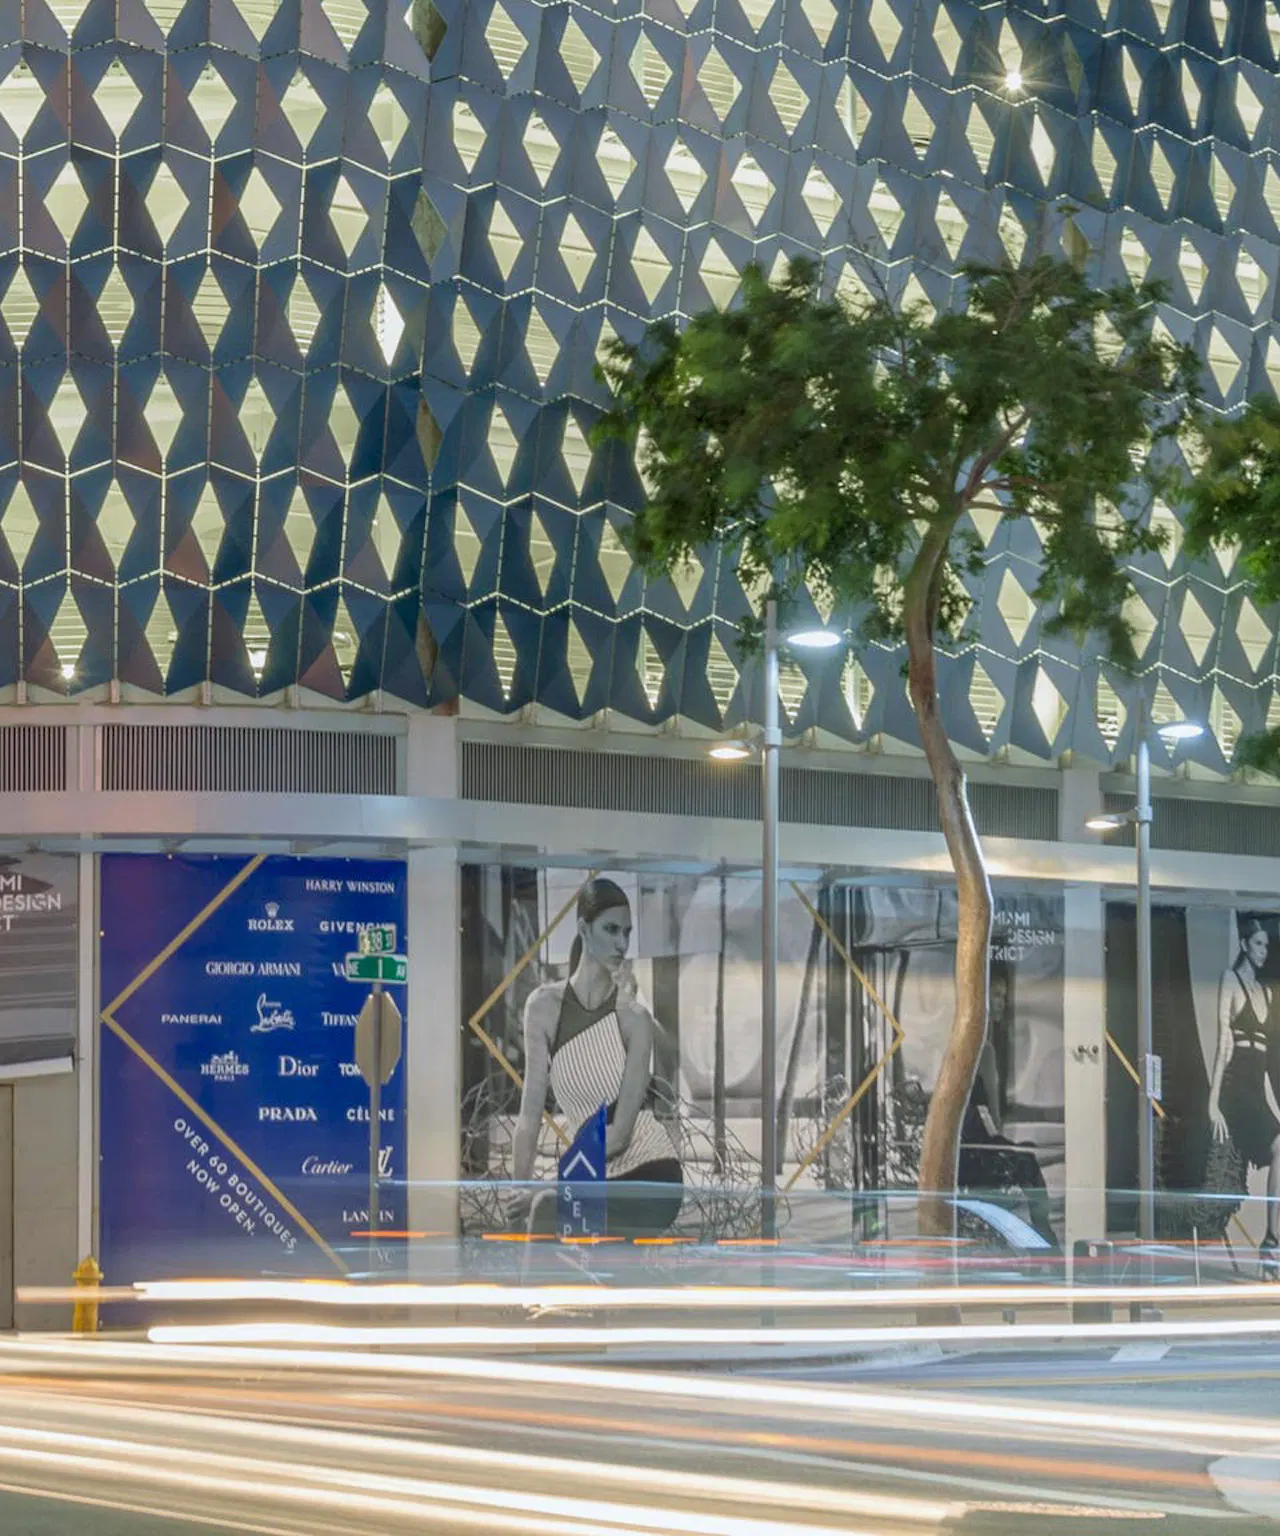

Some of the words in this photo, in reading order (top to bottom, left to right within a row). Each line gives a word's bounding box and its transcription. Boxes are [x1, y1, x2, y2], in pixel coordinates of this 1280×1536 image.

[305, 879, 342, 892] HARRY
[346, 881, 396, 894] WINSTON
[248, 918, 295, 931] ROLEX
[319, 921, 382, 933] GIVEN
[990, 945, 1025, 960] TRICT
[205, 961, 255, 975] GIORGIO
[257, 962, 301, 976] ARMANI
[160, 1014, 222, 1025] PANERAI
[320, 1011, 361, 1026] TIFFAN
[278, 1055, 320, 1077] Dior
[258, 1107, 318, 1121] PRADA
[346, 1105, 395, 1122] CÉLNE
[301, 1155, 354, 1176] Cartier
[173, 1118, 209, 1157] OVER
[208, 1155, 228, 1175] 60
[227, 1173, 297, 1249] BOUTIQUES
[186, 1159, 220, 1193] NOW
[220, 1193, 256, 1237] OPEN.
[342, 1210, 395, 1224] LANIN
